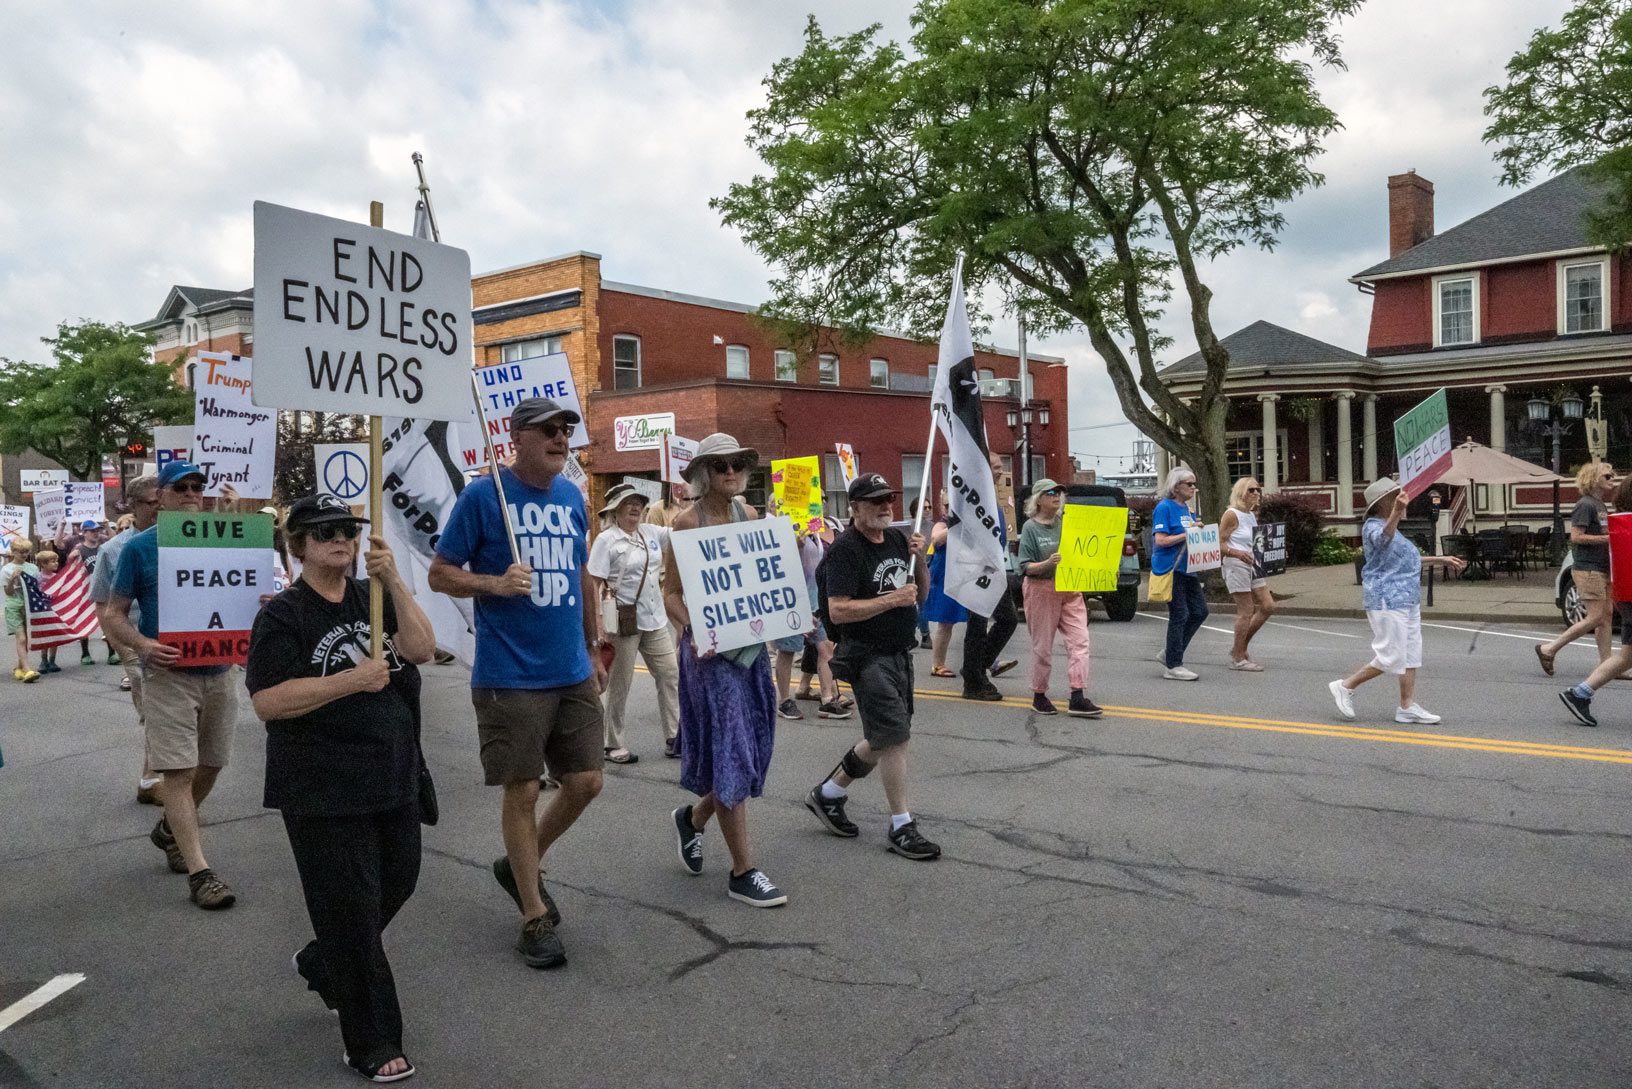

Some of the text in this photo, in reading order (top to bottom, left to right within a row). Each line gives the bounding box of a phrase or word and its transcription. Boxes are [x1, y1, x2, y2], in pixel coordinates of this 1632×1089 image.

[333, 237, 424, 293] END
[283, 278, 458, 356] ENDLESS
[201, 358, 251, 395] Trump
[305, 346, 424, 404] WARS
[475, 365, 522, 386] UND
[203, 397, 270, 425] Warmonger
[201, 436, 254, 455] Criminal
[1405, 429, 1447, 480] PEACE
[202, 462, 250, 489] Tyrant
[182, 520, 244, 539] GIVE
[508, 502, 578, 537] LOCK
[520, 535, 576, 571] HIM
[698, 528, 780, 562] WE WILL
[1073, 534, 1117, 558] NOT
[1188, 530, 1217, 545] NO WAR
[700, 554, 786, 595] NOT BE
[1189, 553, 1201, 565] NO
[176, 569, 257, 587] PEACE
[530, 572, 576, 607] UP.
[207, 611, 224, 629] A
[703, 586, 797, 629] SILENCED
